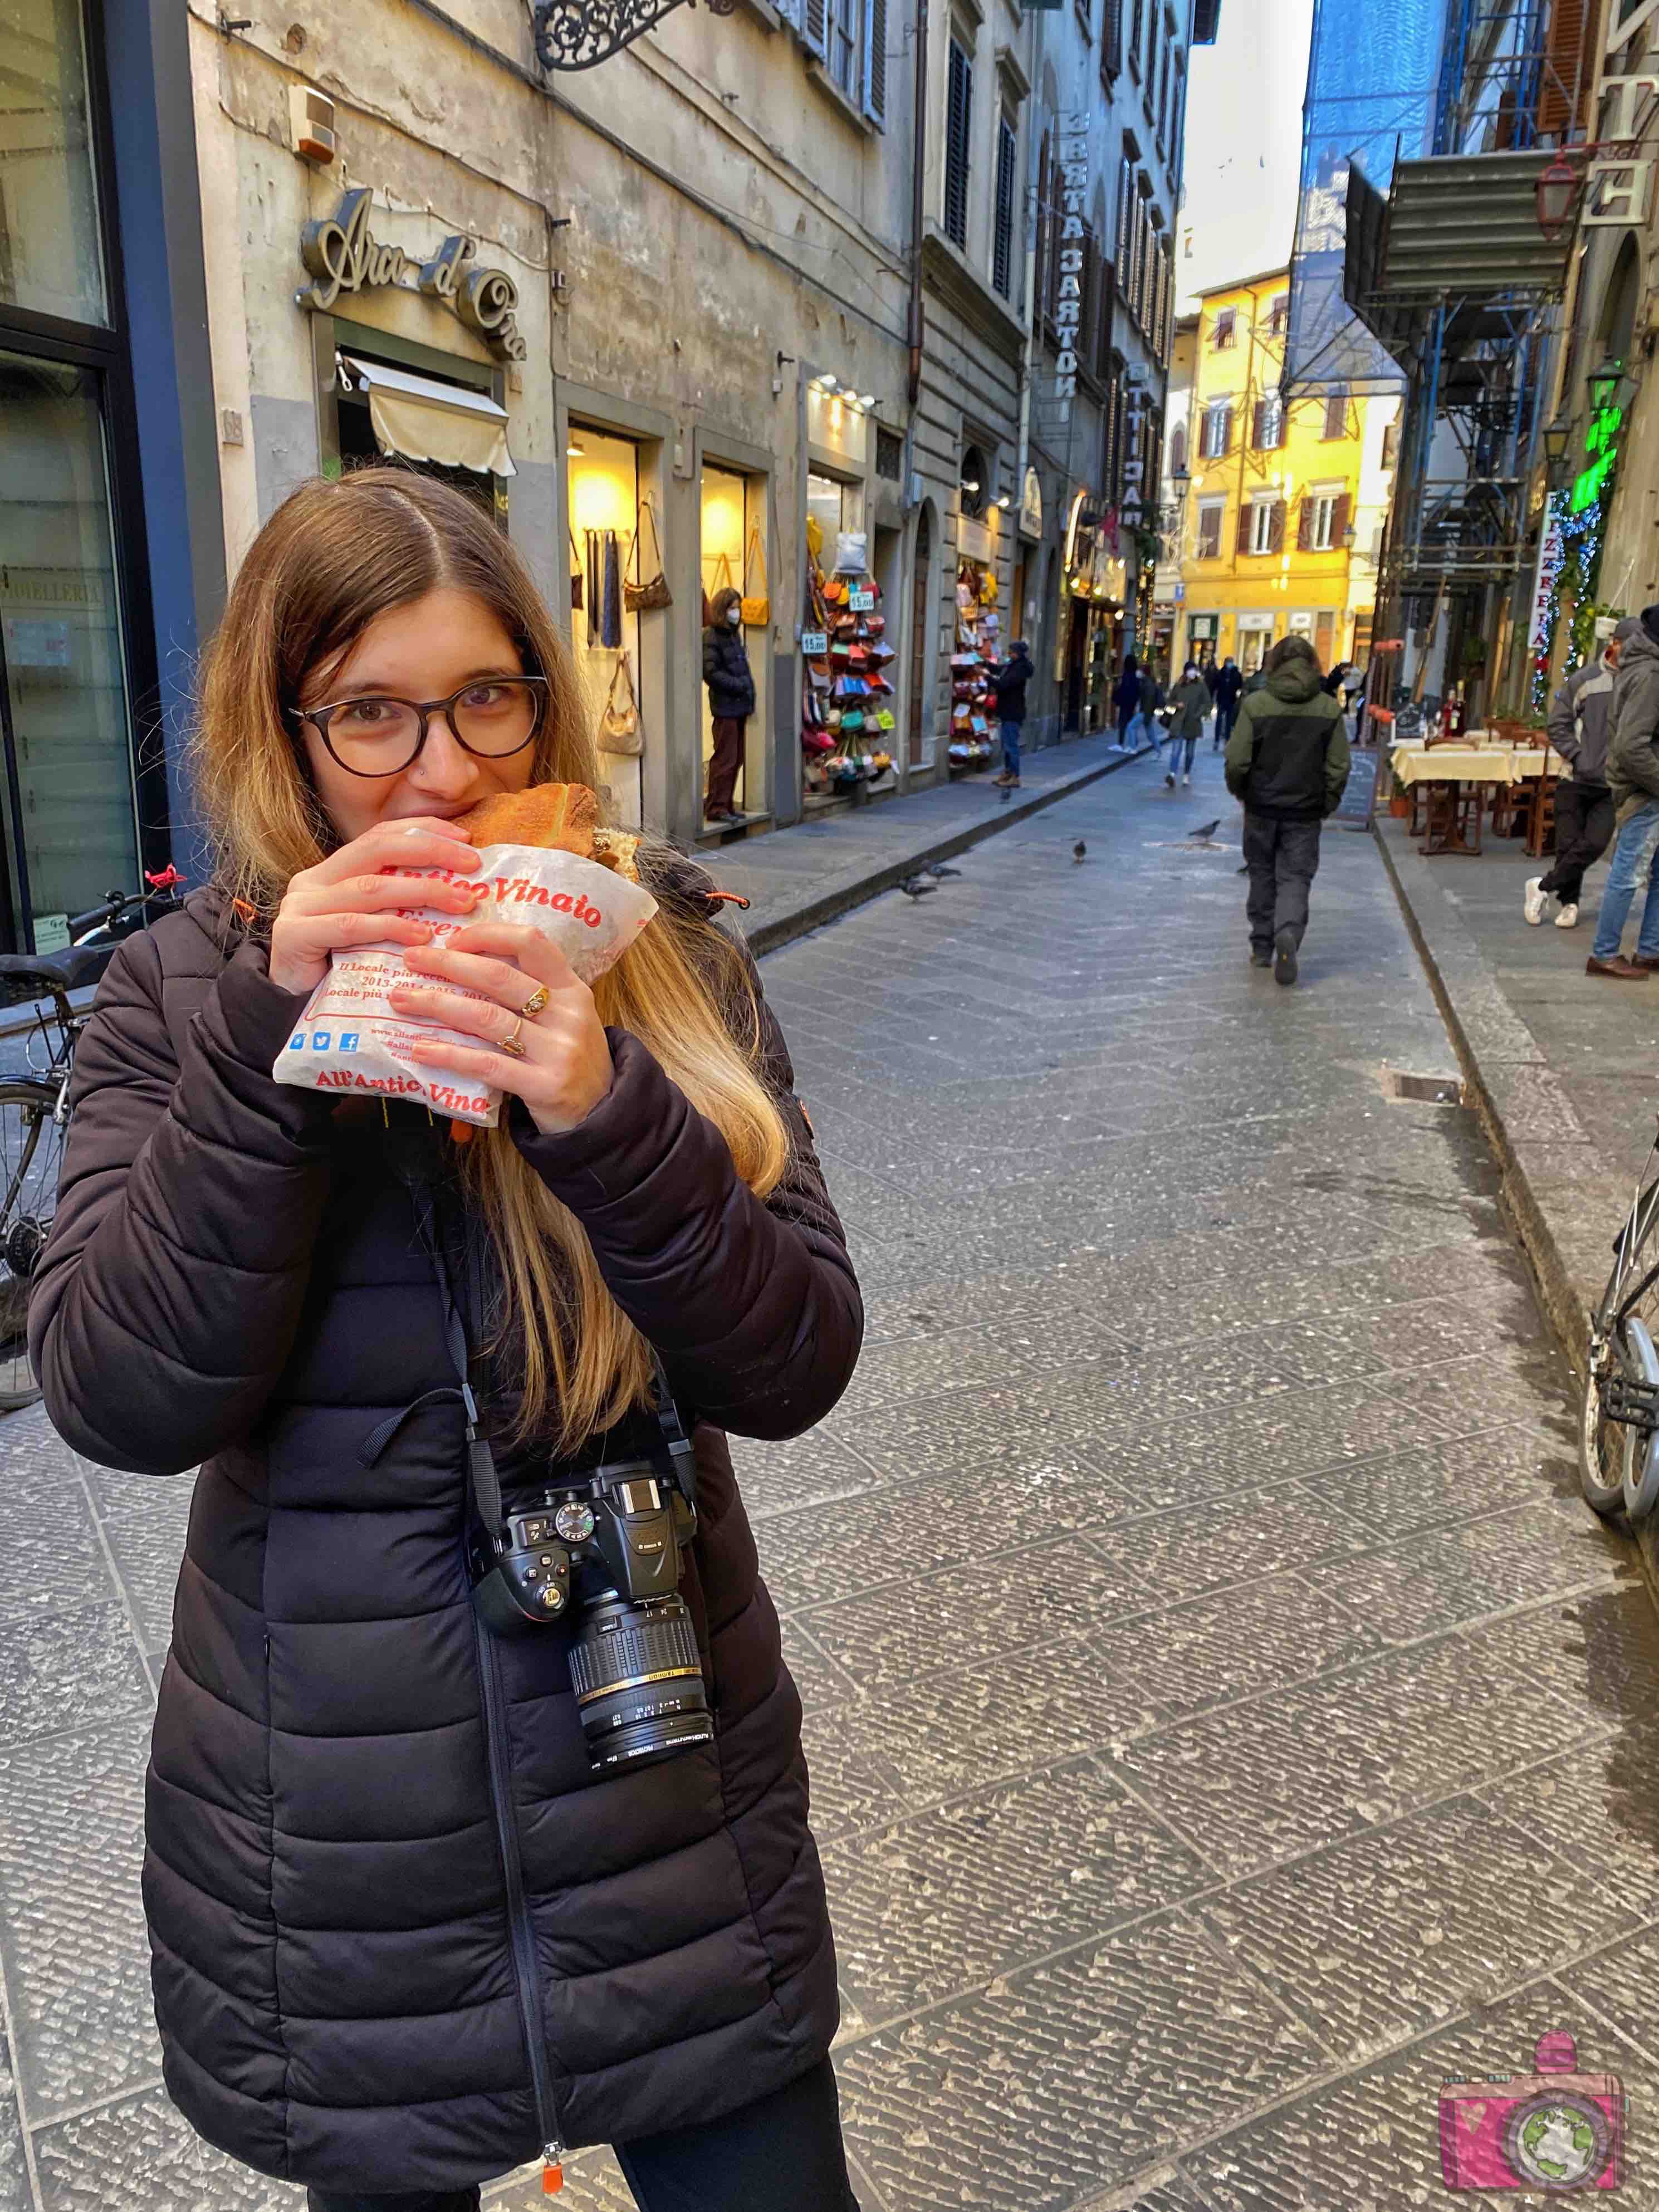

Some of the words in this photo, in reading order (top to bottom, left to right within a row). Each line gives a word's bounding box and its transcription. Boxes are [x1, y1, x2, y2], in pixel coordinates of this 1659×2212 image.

[298, 188, 407, 309] Arco
[494, 877, 601, 928] Vinaio
[351, 962, 389, 974] Locale
[324, 986, 359, 999] Locale
[362, 987, 383, 1002] più
